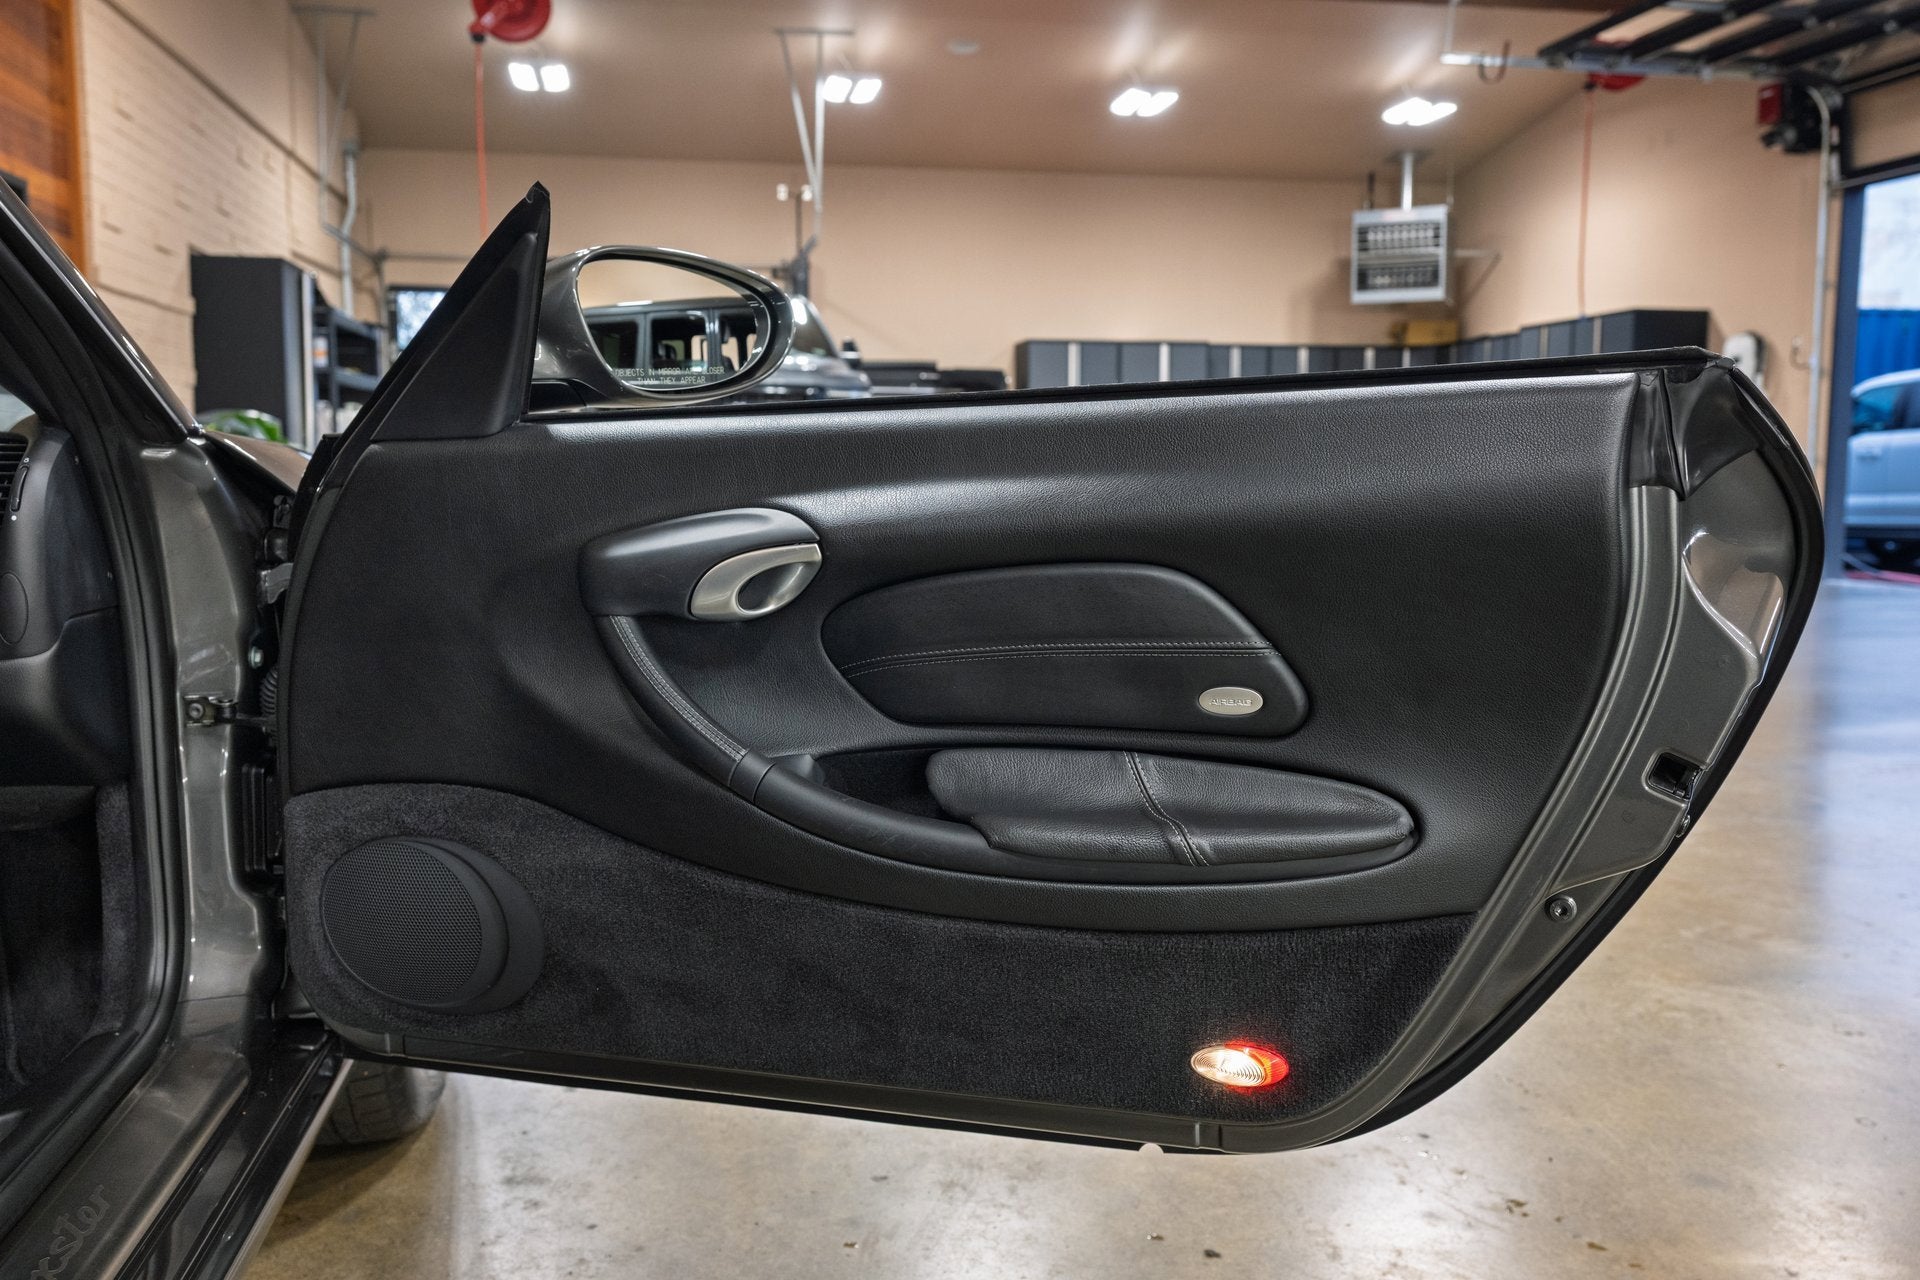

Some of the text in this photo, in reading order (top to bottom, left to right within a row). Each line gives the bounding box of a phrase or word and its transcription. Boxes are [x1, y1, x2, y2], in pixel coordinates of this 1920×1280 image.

[615, 368, 644, 377] OBJECTS
[648, 368, 655, 376] IN
[658, 367, 680, 375] MIRROR
[681, 376, 706, 384] APPEAR
